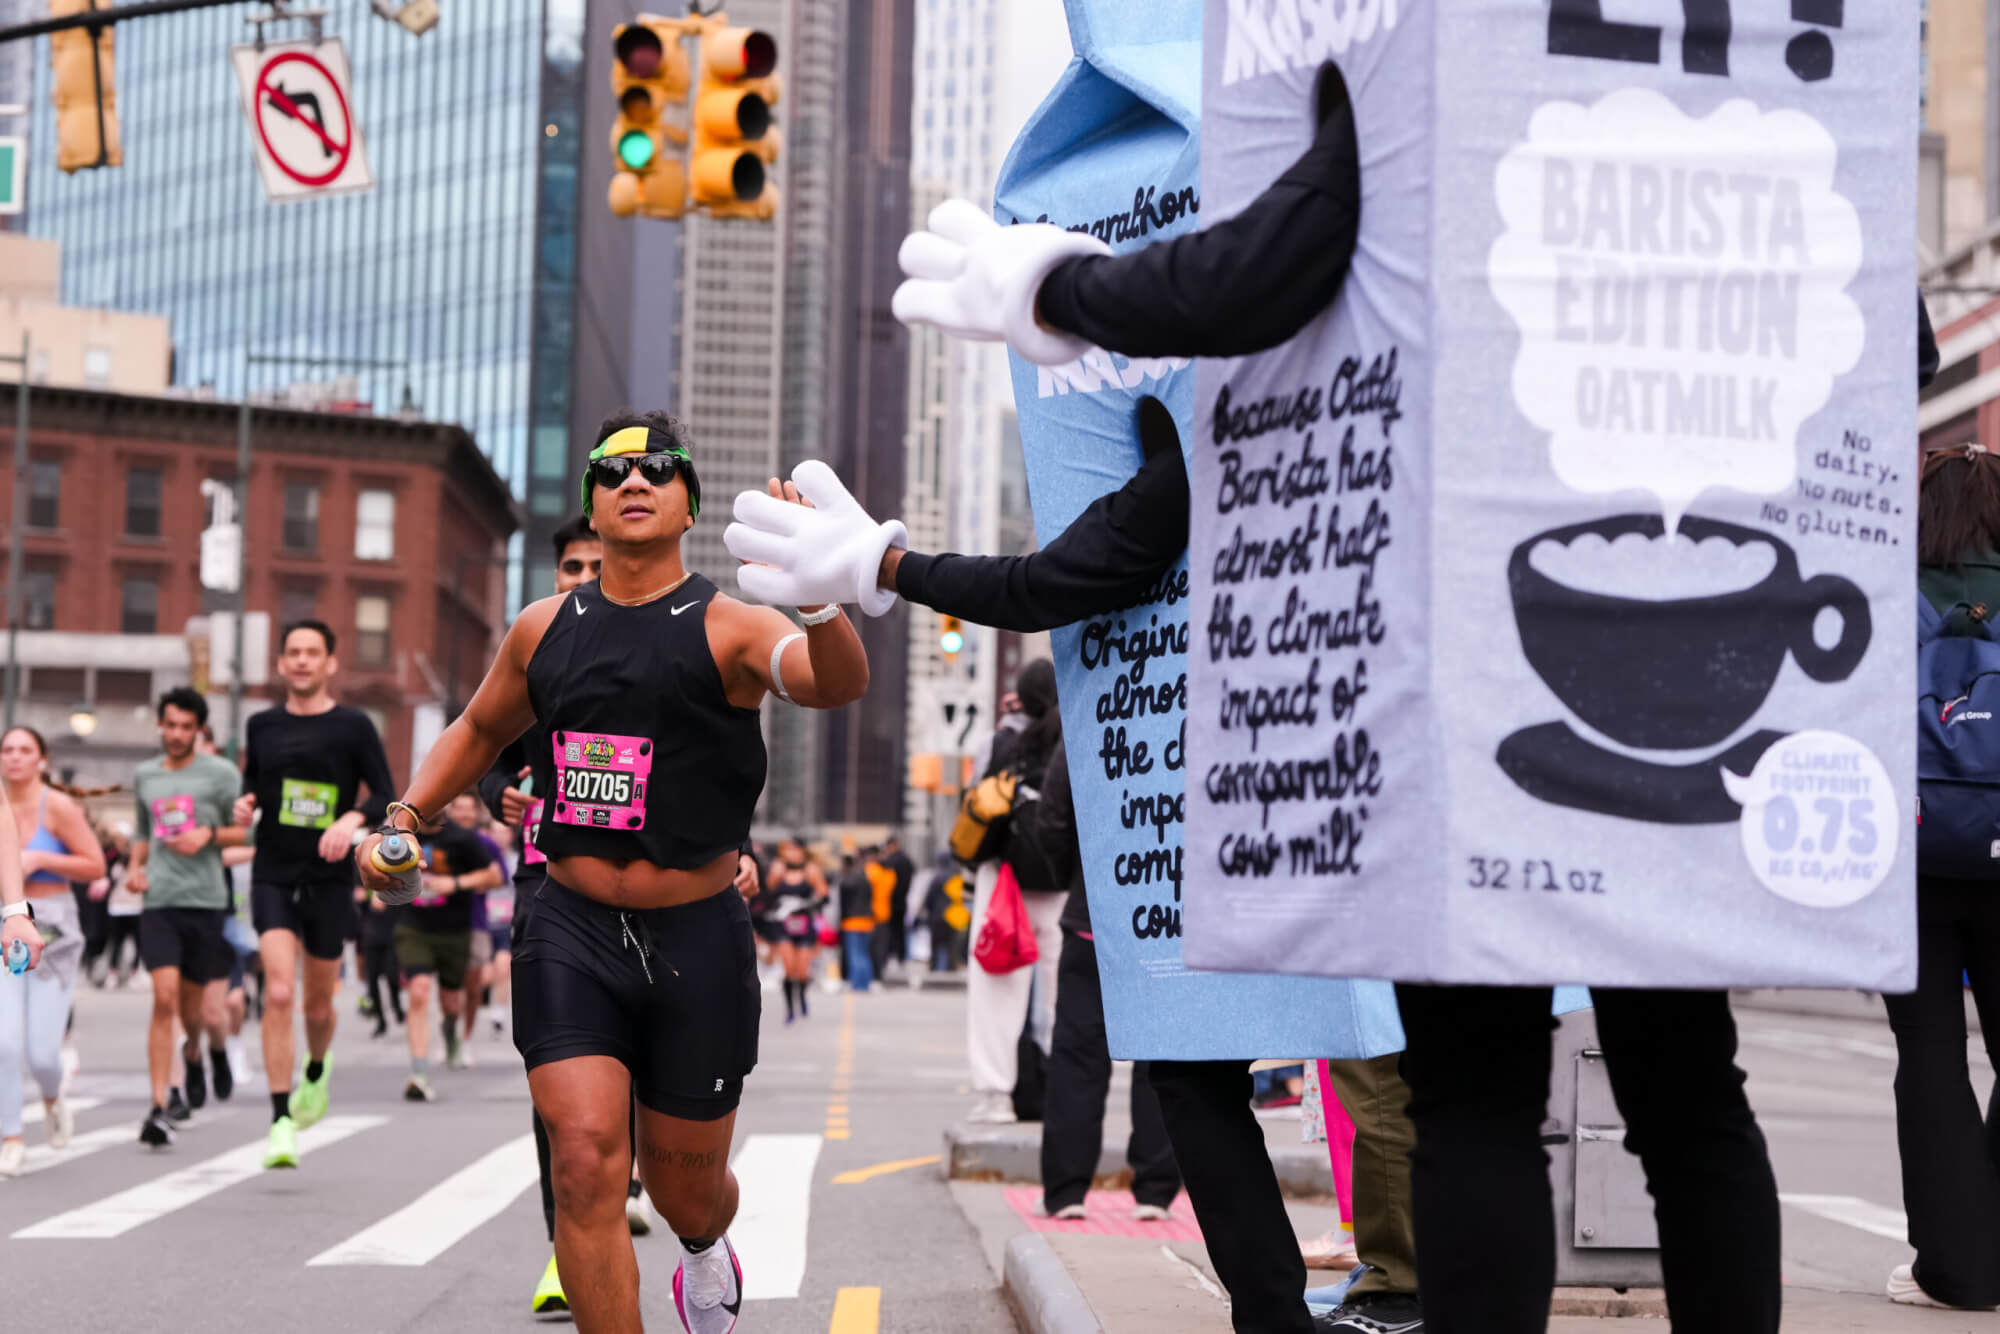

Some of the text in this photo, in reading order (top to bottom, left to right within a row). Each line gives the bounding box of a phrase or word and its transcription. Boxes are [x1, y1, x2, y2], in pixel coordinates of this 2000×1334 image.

[1540, 155, 1811, 265] BARISTA
[1553, 254, 1801, 360] EDITION
[1212, 346, 1402, 446] because Oatly
[1574, 365, 1779, 442] OATMILK
[1216, 424, 1393, 515] Barista has
[1815, 450, 1900, 485] dairy.
[1842, 429, 1871, 452] No
[1760, 503, 1900, 546] No gluten.
[1797, 478, 1902, 516] No nuts.
[1213, 498, 1391, 588] almost half
[1208, 572, 1386, 663] the climate
[1220, 657, 1369, 753] impact of
[1099, 726, 1154, 780] the
[1206, 729, 1384, 830] comparable
[1780, 751, 1861, 772] CLIMATE
[566, 769, 630, 803] 20705
[634, 783, 643, 800] A
[1769, 773, 1872, 795] FOOTPRINT
[1763, 794, 1878, 856] 0.75
[1218, 832, 1282, 878] cow
[1469, 856, 1606, 894] 32 fl oz
